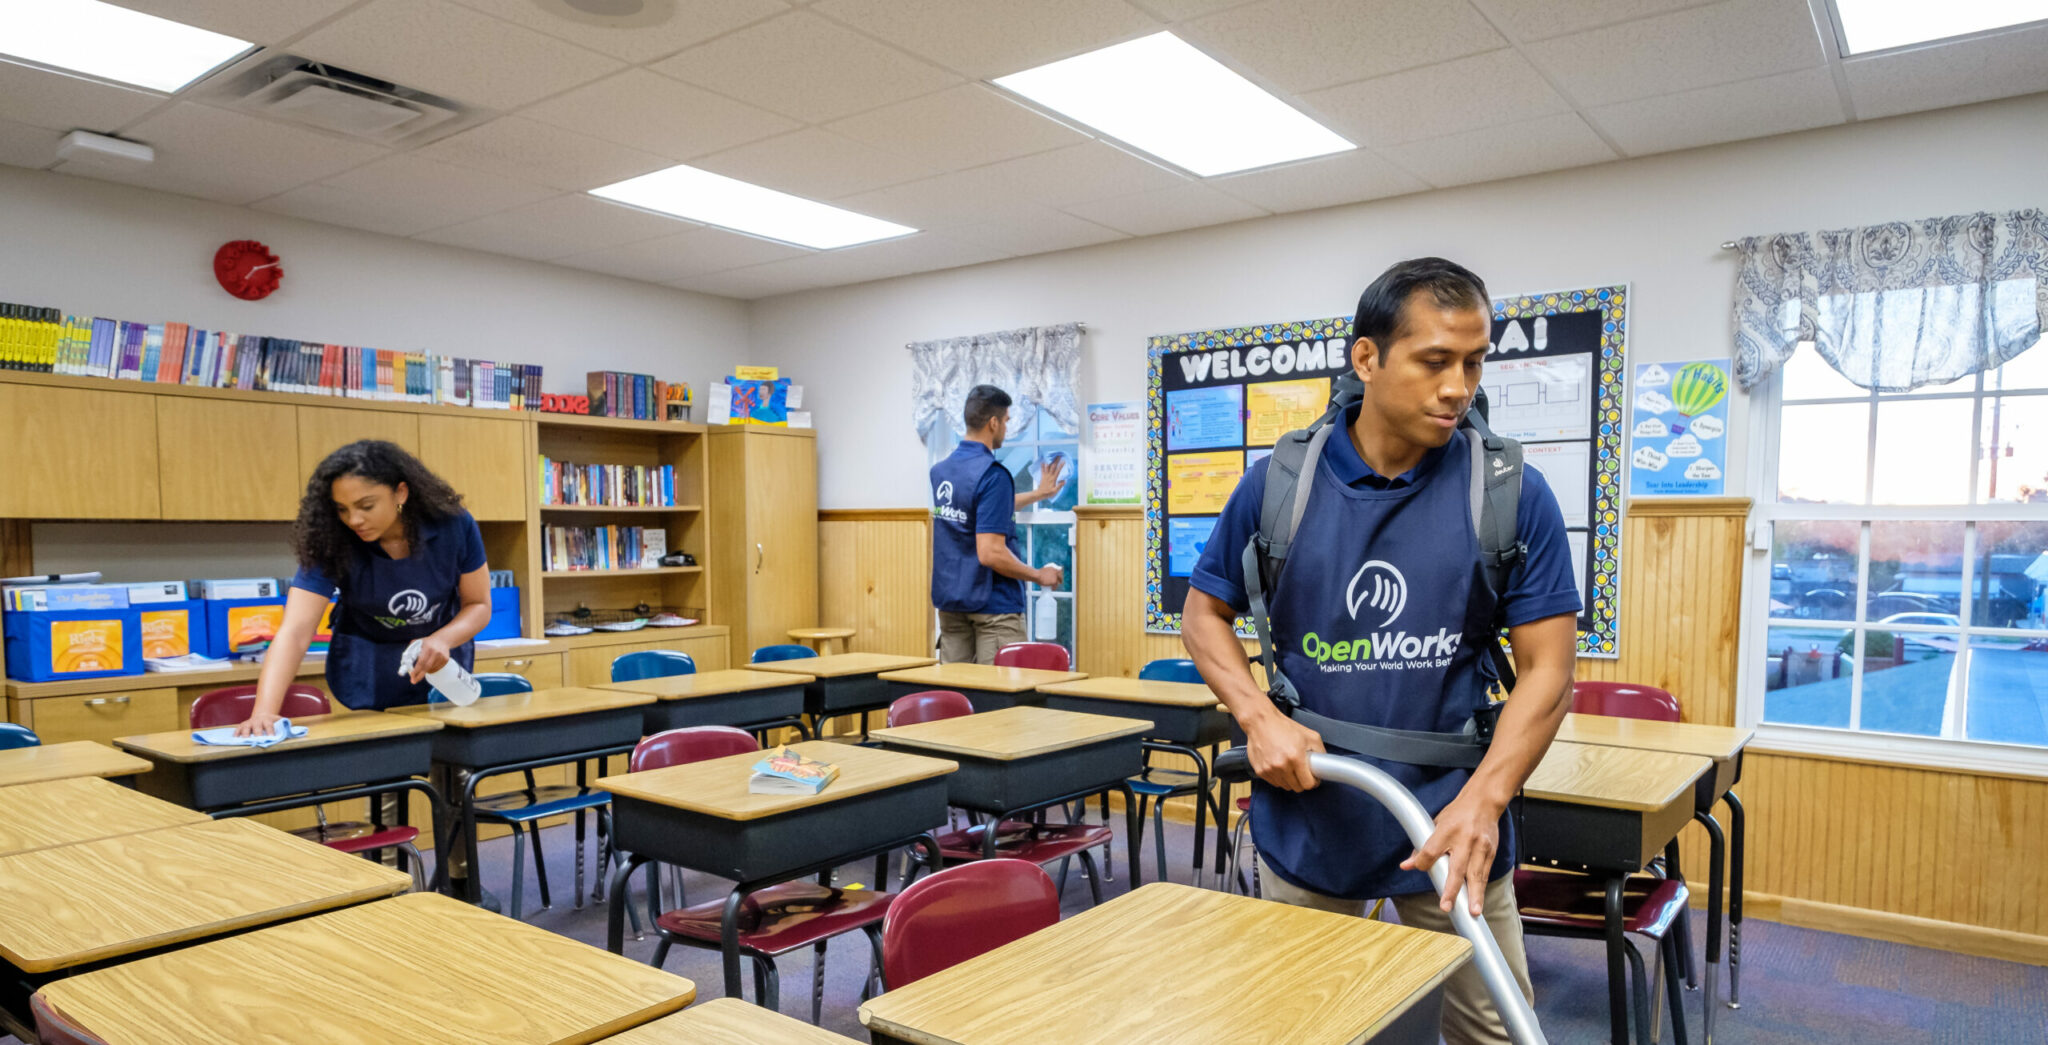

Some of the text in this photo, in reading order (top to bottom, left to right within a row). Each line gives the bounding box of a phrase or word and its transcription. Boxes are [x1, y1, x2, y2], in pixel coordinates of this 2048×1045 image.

[1179, 337, 1346, 384] WELCOME
[1693, 367, 1725, 394] Habits
[1527, 446, 1562, 454] CONTEXT
[1094, 463, 1135, 471] SERVICE
[1320, 662, 1352, 673] Making
[1355, 661, 1377, 671] Your
[1379, 660, 1403, 670] World
[1406, 659, 1433, 669] Work
